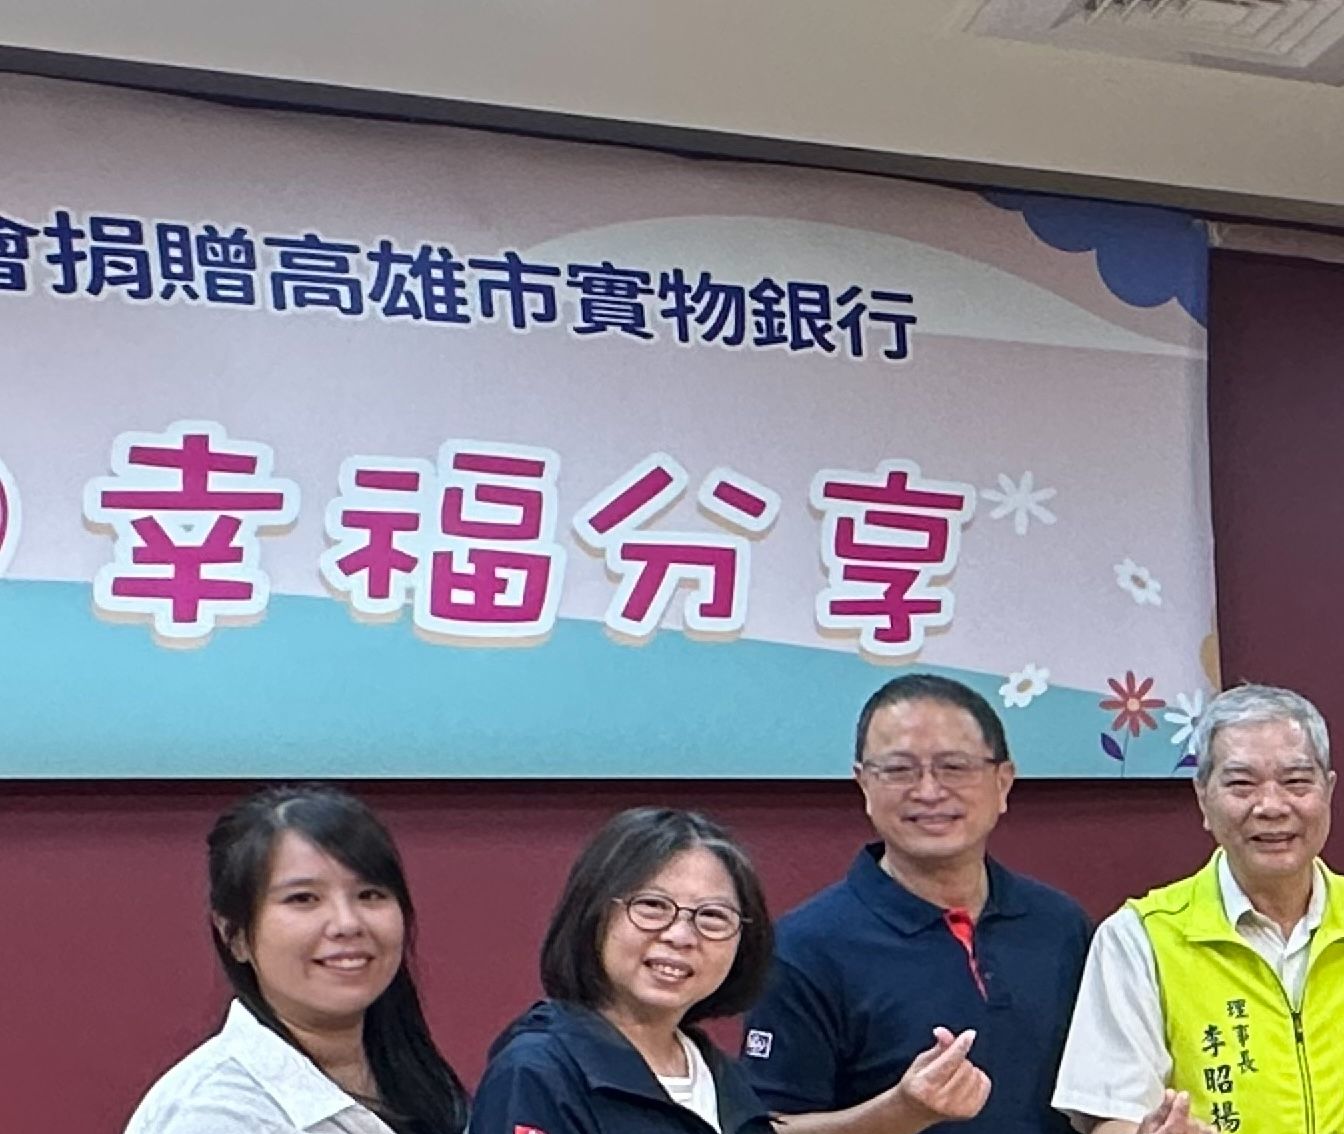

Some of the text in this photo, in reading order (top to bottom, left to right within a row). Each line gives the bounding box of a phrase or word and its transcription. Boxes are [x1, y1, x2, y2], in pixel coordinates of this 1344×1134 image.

[100, 433, 965, 645] 幸福分享
[1227, 999, 1259, 1074] 理事長
